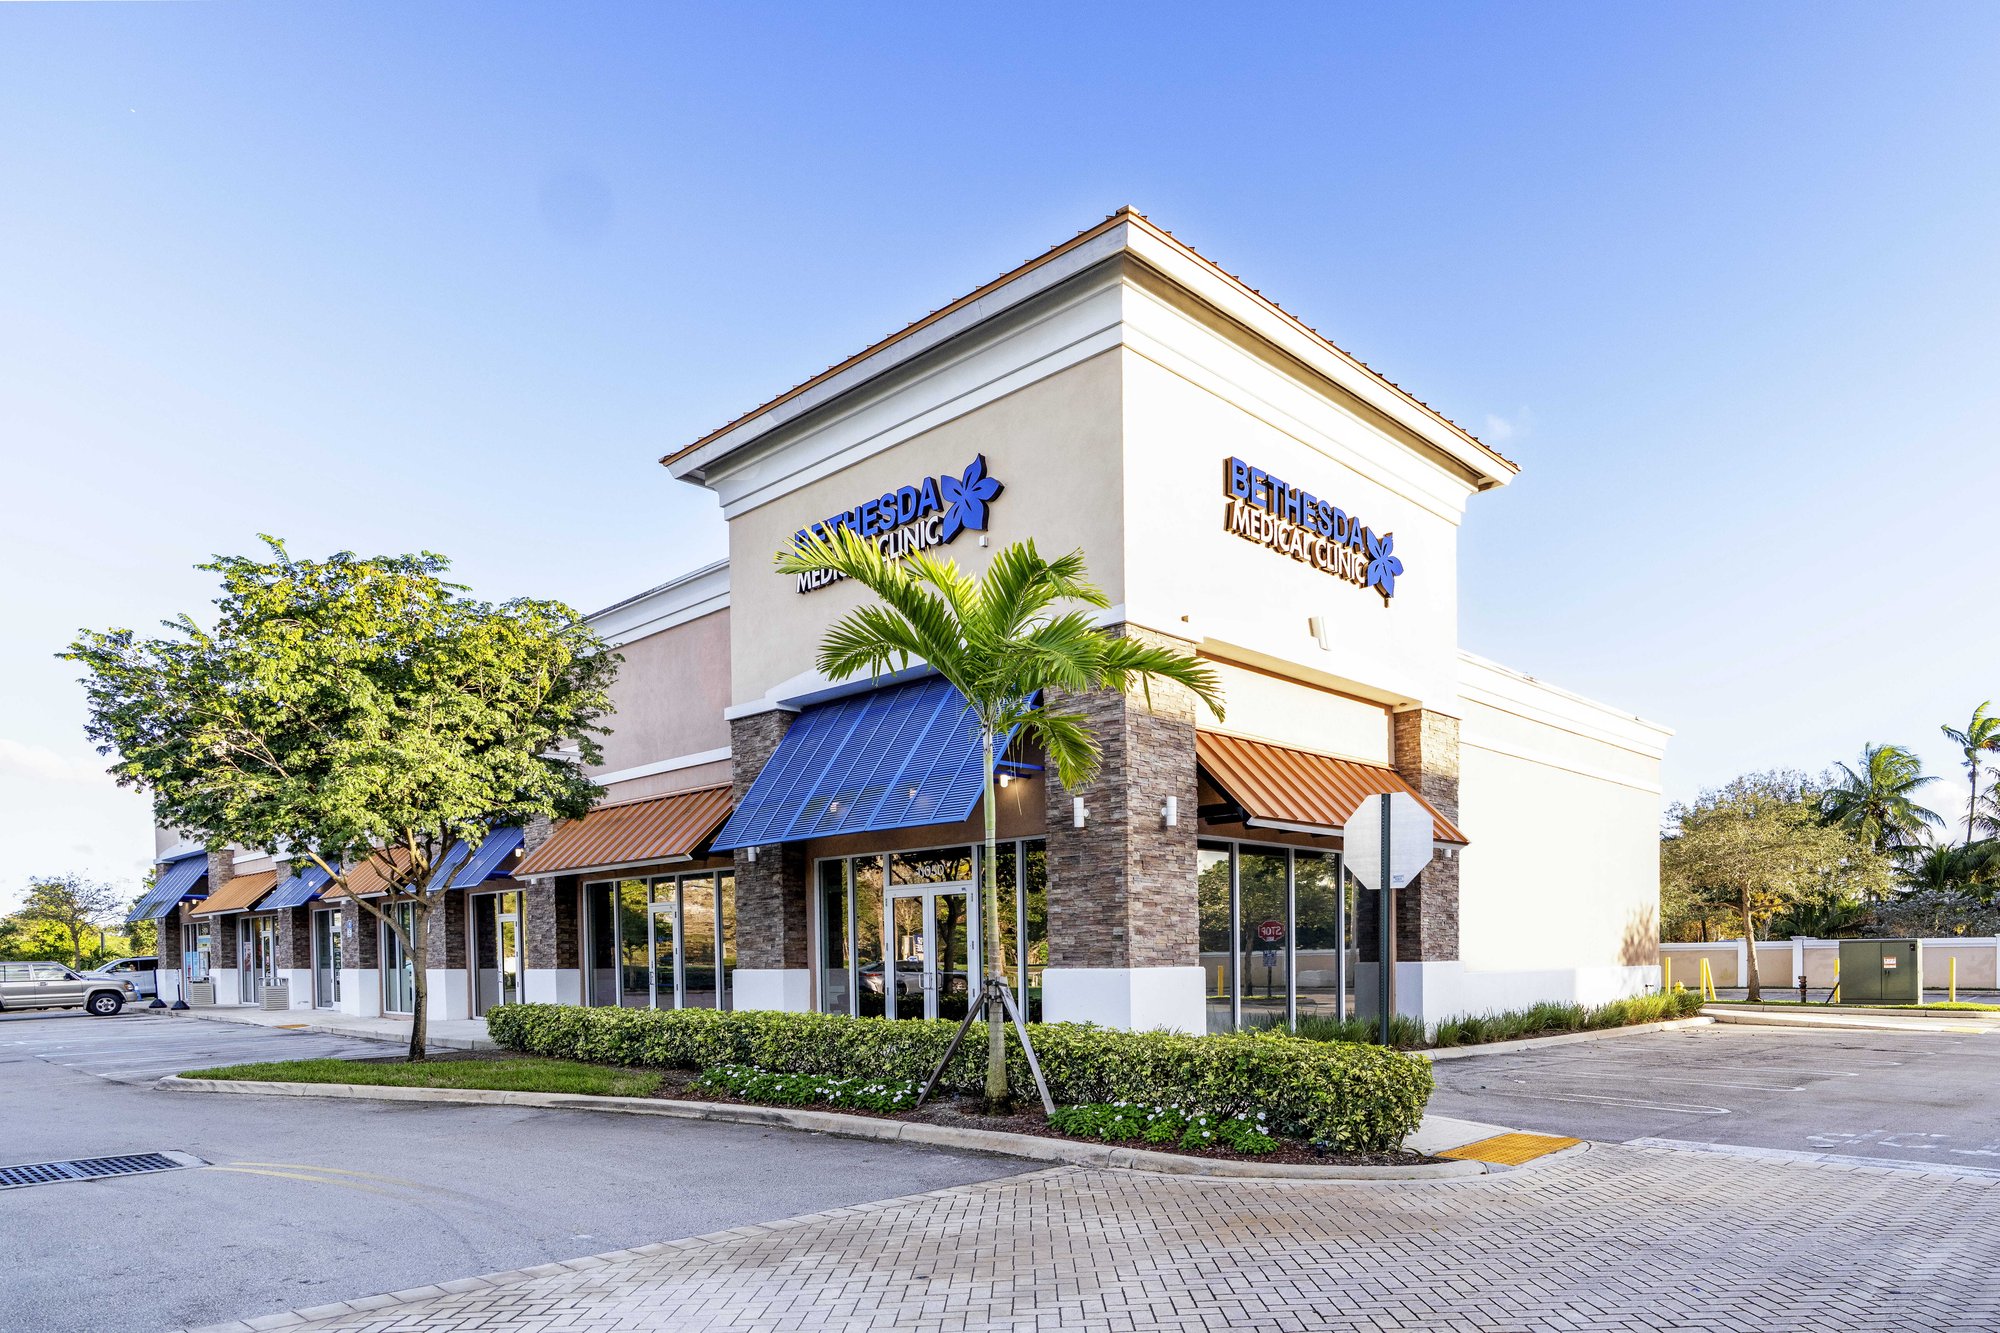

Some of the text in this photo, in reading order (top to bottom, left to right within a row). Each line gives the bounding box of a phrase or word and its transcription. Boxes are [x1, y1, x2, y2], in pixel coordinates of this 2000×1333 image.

[877, 515, 941, 562] CLINIC
[1224, 456, 1366, 554] BETHESDA
[1226, 499, 1366, 584] MEDICAL CLINIC
